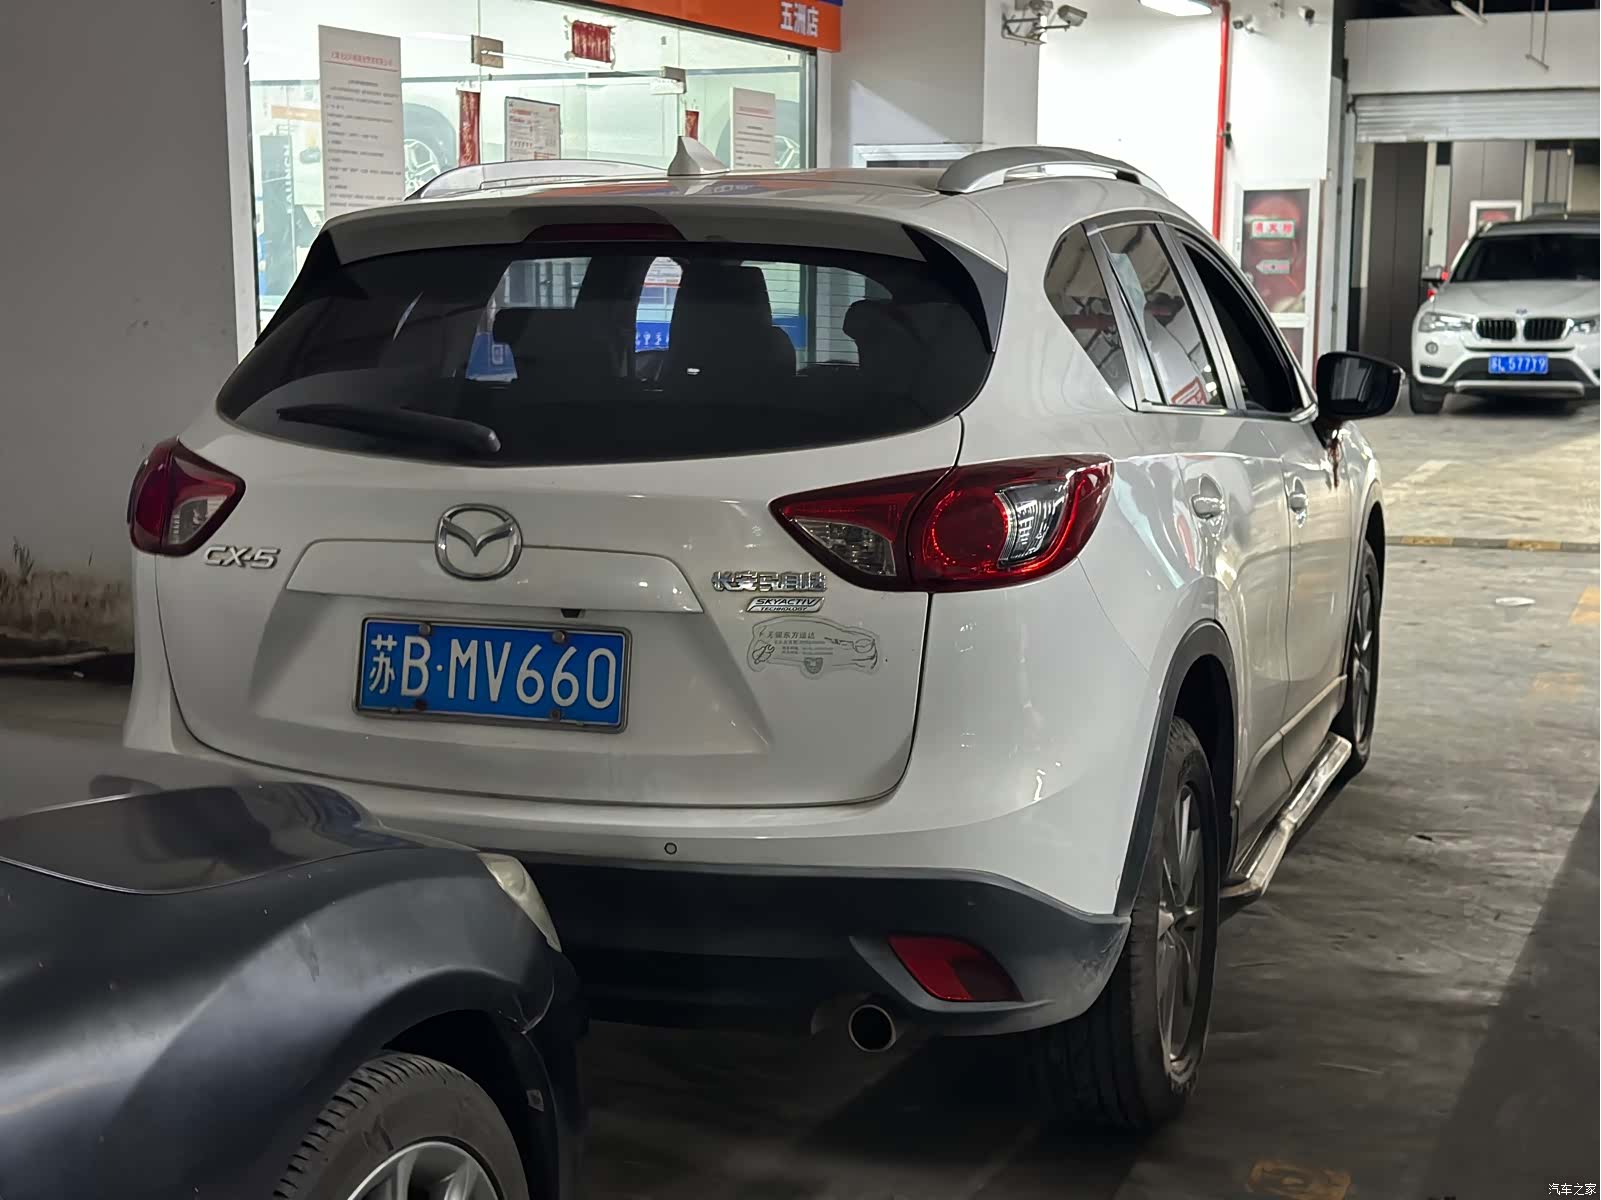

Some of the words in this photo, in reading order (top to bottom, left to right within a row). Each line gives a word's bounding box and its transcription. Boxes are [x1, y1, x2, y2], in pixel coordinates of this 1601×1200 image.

[780, 1, 820, 39] 五洲店
[204, 545, 280, 569] CX-5
